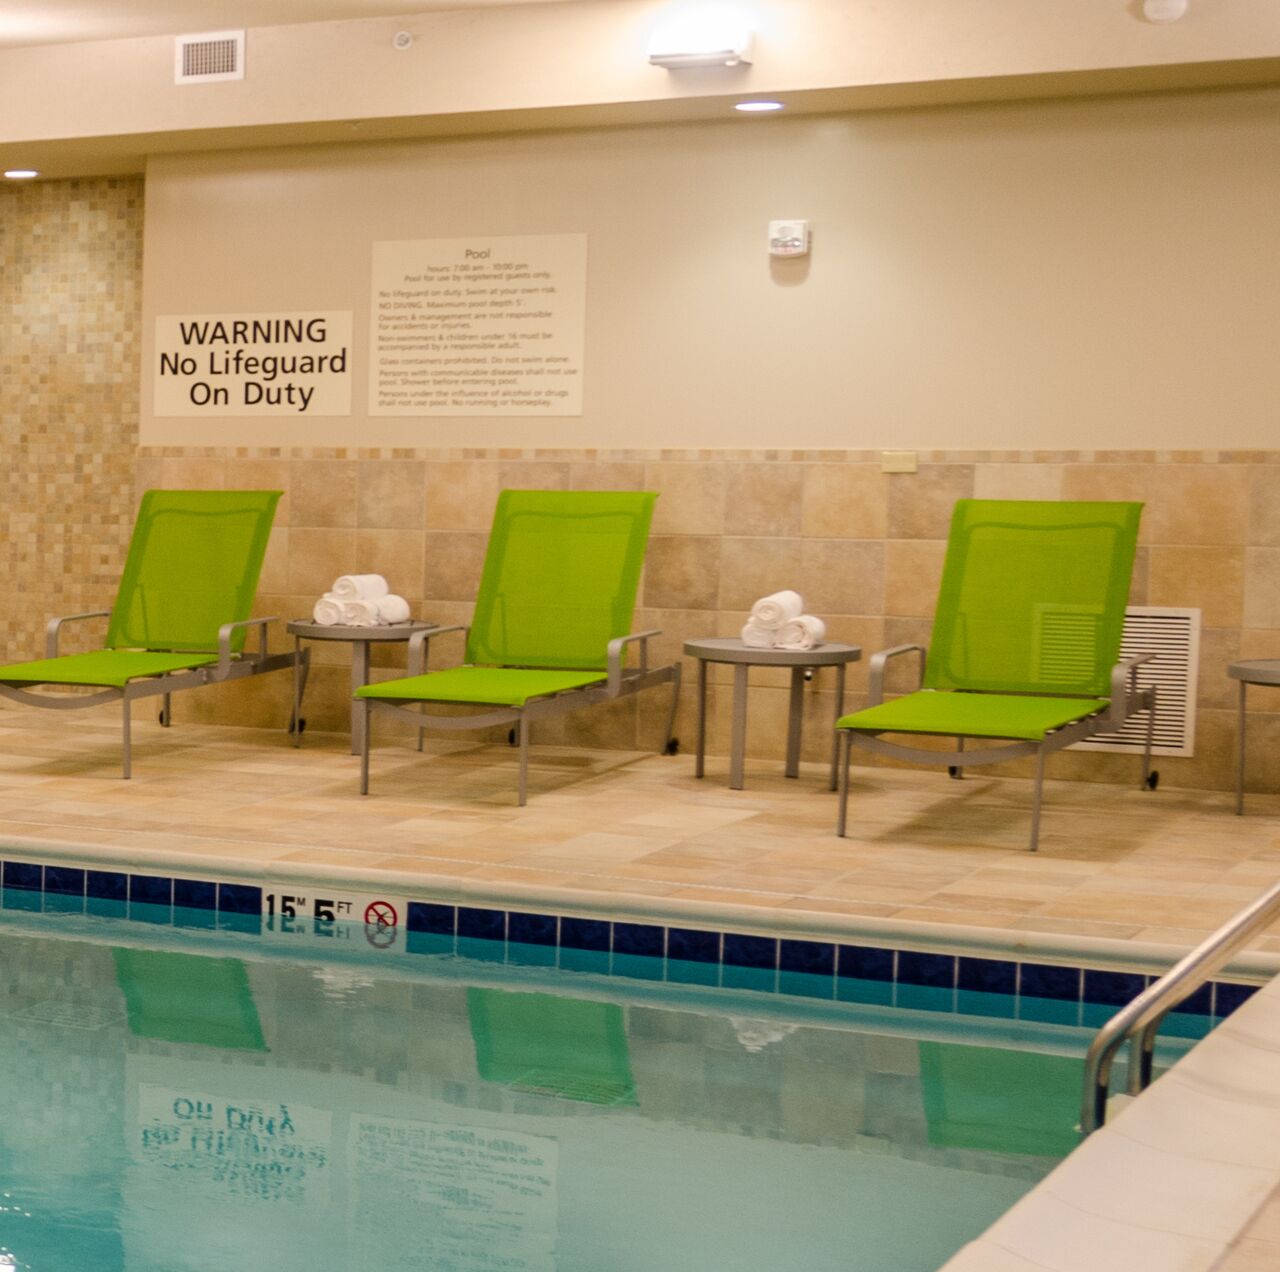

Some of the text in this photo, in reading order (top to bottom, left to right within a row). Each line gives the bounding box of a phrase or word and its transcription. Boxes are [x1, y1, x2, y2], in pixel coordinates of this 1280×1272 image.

[465, 248, 491, 260] Pool
[180, 318, 327, 345] WARNING
[160, 347, 347, 381] No Lifeguard
[190, 381, 315, 412] On Duty
